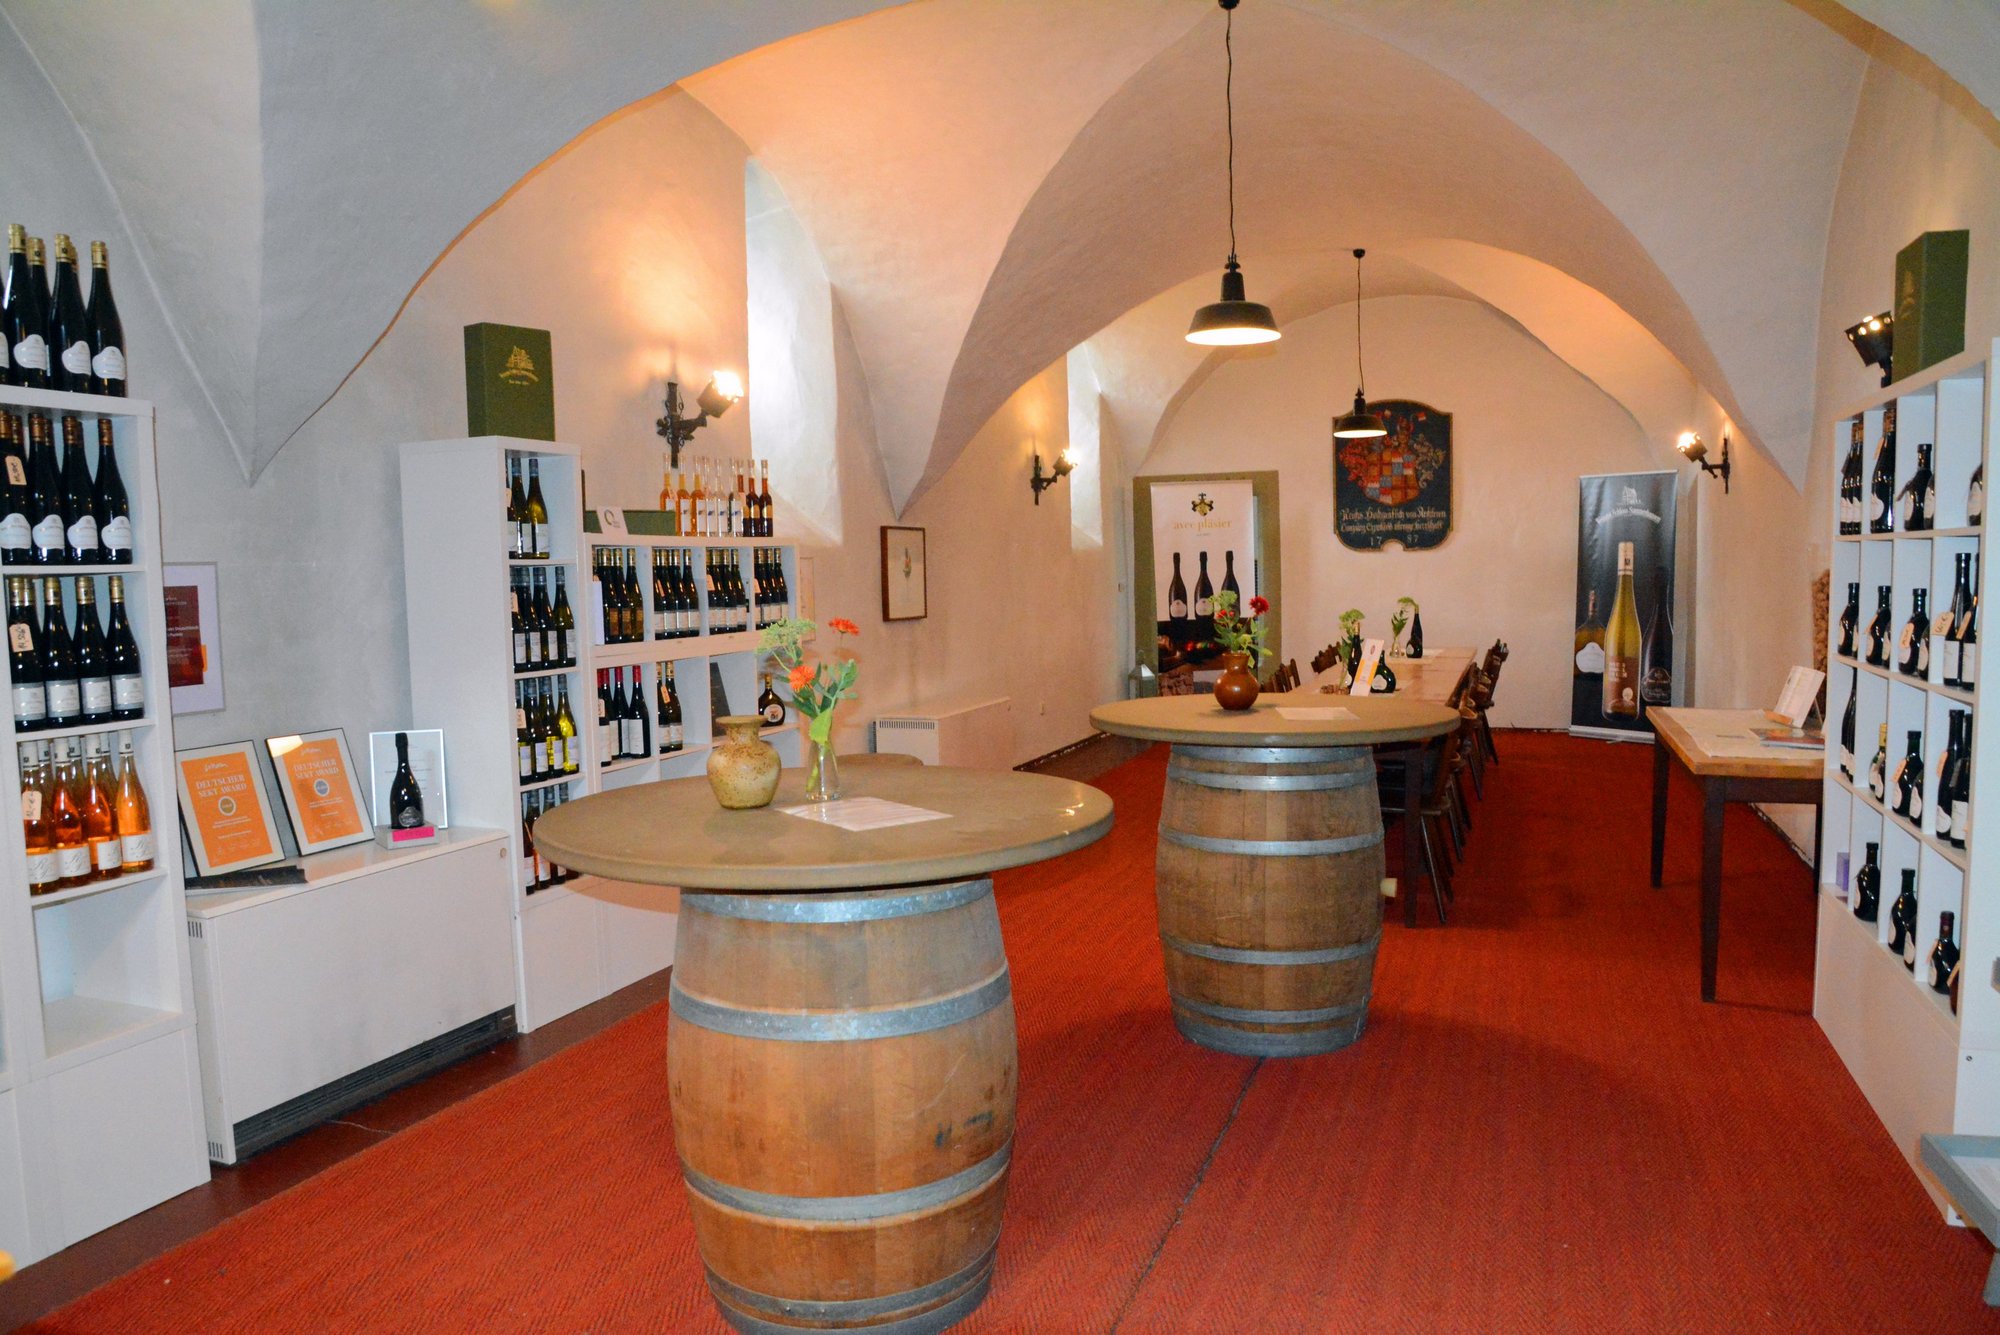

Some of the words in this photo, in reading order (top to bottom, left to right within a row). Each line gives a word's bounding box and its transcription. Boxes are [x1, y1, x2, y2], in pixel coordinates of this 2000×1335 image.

[293, 758, 337, 772] DEUTSCHER
[315, 767, 340, 777] AWARD
[195, 774, 246, 789] DEUTSCHER
[198, 789, 218, 798] SEKT
[220, 783, 248, 794] AWARD
